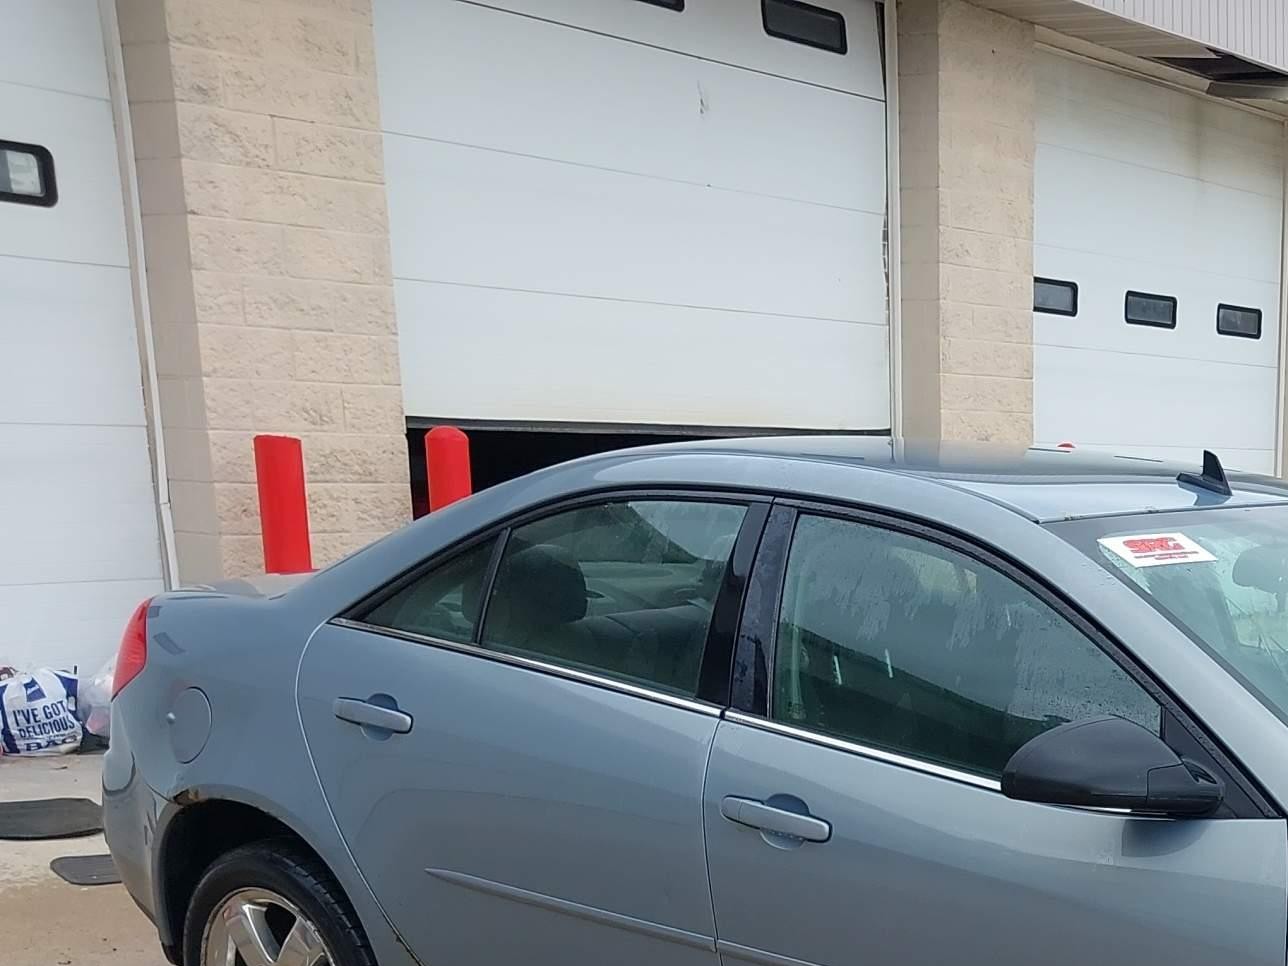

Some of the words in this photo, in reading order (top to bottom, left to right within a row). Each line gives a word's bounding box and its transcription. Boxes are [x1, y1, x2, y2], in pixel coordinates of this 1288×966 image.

[14, 708, 41, 727] I'VE
[42, 701, 67, 720] GOT
[18, 715, 75, 738] DELICIOUS
